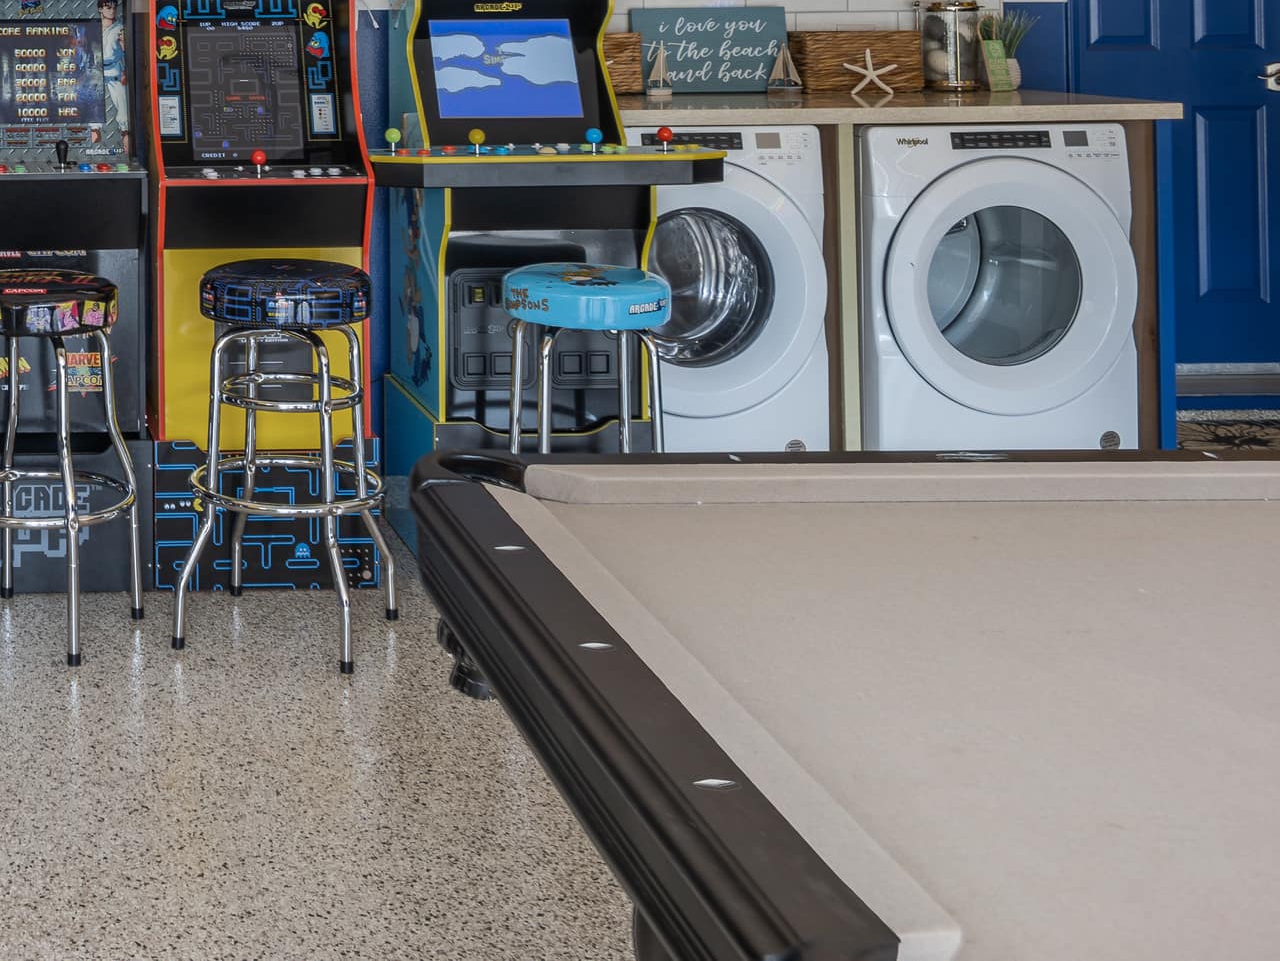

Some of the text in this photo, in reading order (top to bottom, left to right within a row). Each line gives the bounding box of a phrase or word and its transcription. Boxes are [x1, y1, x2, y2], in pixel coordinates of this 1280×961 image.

[26, 27, 70, 36] RANKING
[659, 17, 767, 39] i love you
[14, 49, 46, 57] 50000
[668, 40, 713, 62] the
[719, 39, 780, 60] beach
[15, 64, 46, 72] 40000
[667, 61, 767, 83] and back
[15, 79, 47, 87] 30000
[16, 94, 48, 102] 20000
[18, 108, 48, 117] 10000
[896, 137, 929, 148] Whirlpool
[511, 288, 529, 298] THE
[505, 298, 549, 312] SIMPSONS
[66, 353, 100, 366] ARVE
[66, 375, 102, 386] APCO
